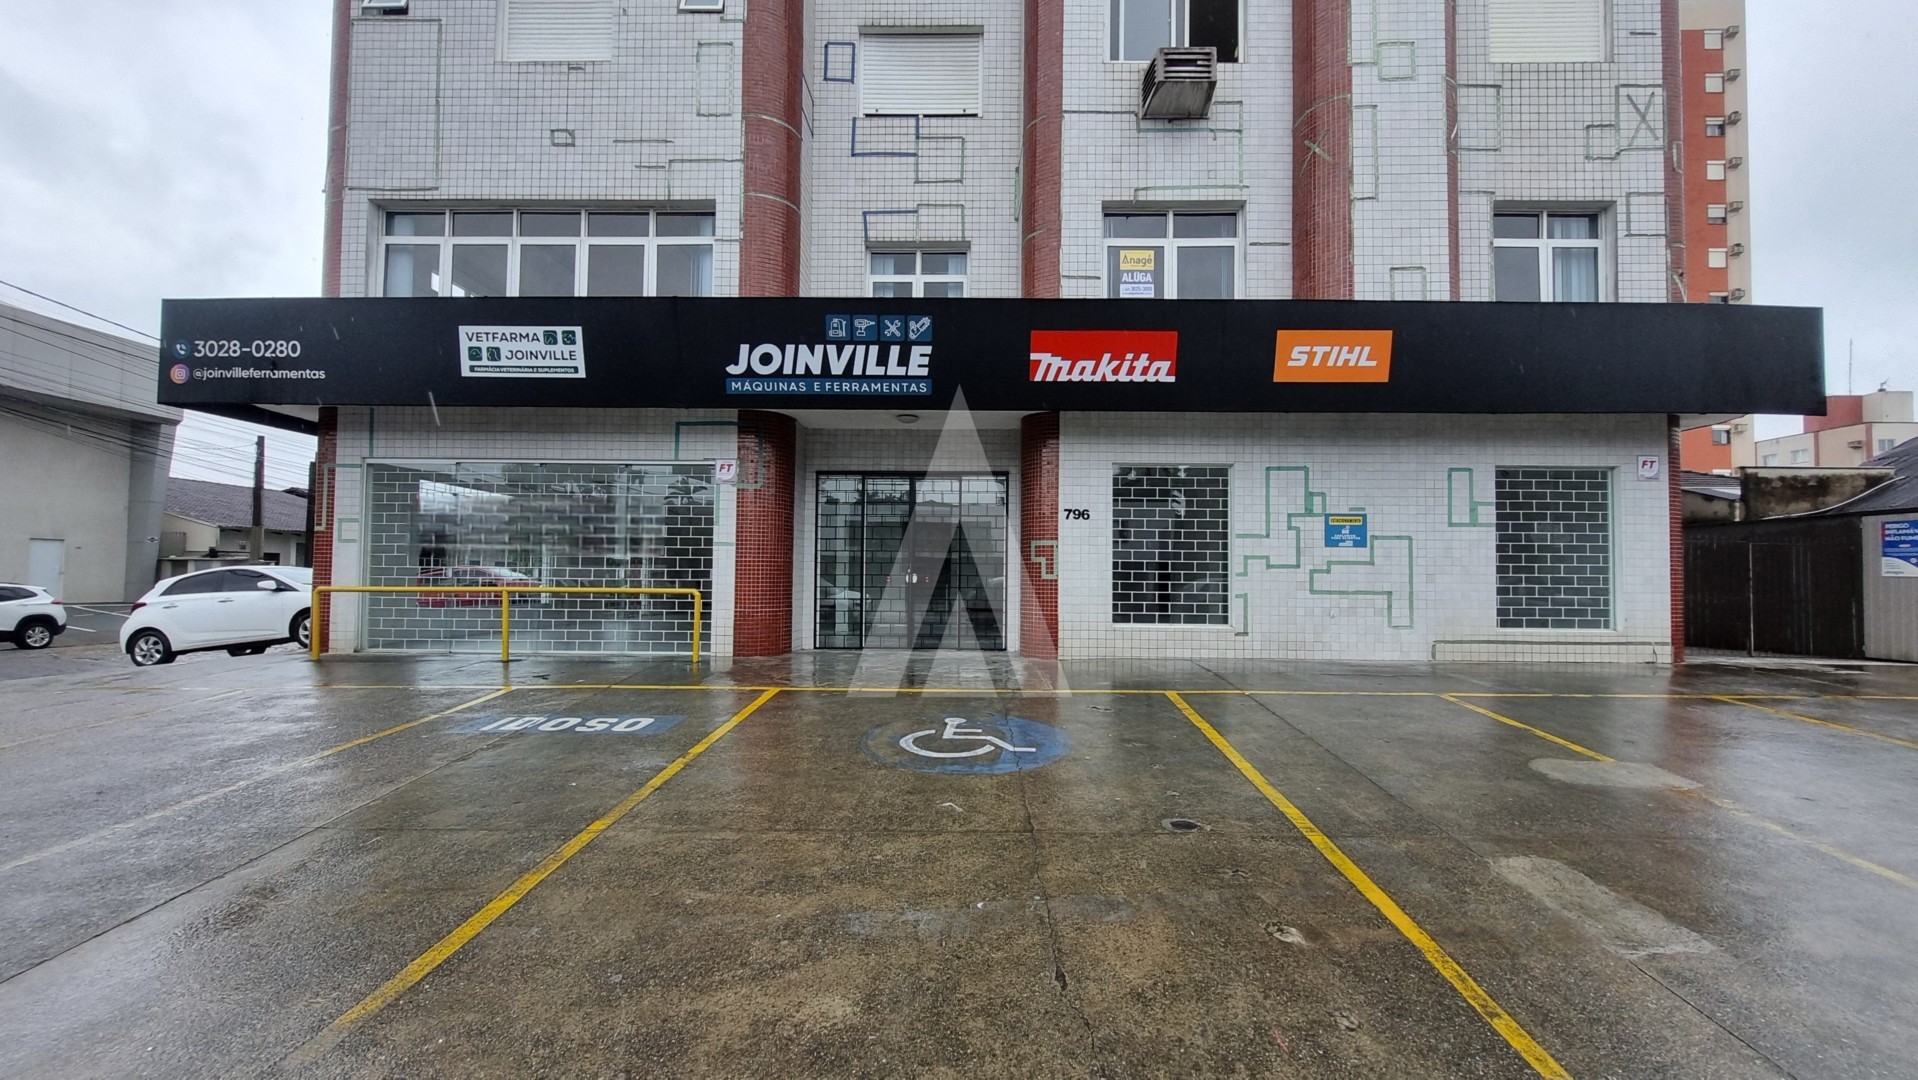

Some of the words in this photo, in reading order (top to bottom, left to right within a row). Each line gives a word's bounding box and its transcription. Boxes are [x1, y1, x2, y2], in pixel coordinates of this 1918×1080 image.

[1121, 271, 1153, 283] ALUGA
[465, 331, 541, 343] VETFARMA
[193, 340, 301, 358] 3028-0280
[505, 350, 577, 361] JOINVILLE
[725, 343, 933, 376] JOINVILLE
[1287, 345, 1378, 367] STIHL
[193, 367, 326, 381] @joinvilleferramentas
[731, 379, 807, 393] MÁQUINAS
[814, 382, 821, 392] E
[825, 383, 928, 393] FERRAMENTAS
[719, 463, 734, 473] FT
[1641, 460, 1657, 470] FT
[1063, 508, 1091, 521] 796
[479, 717, 656, 732] IDOSO
